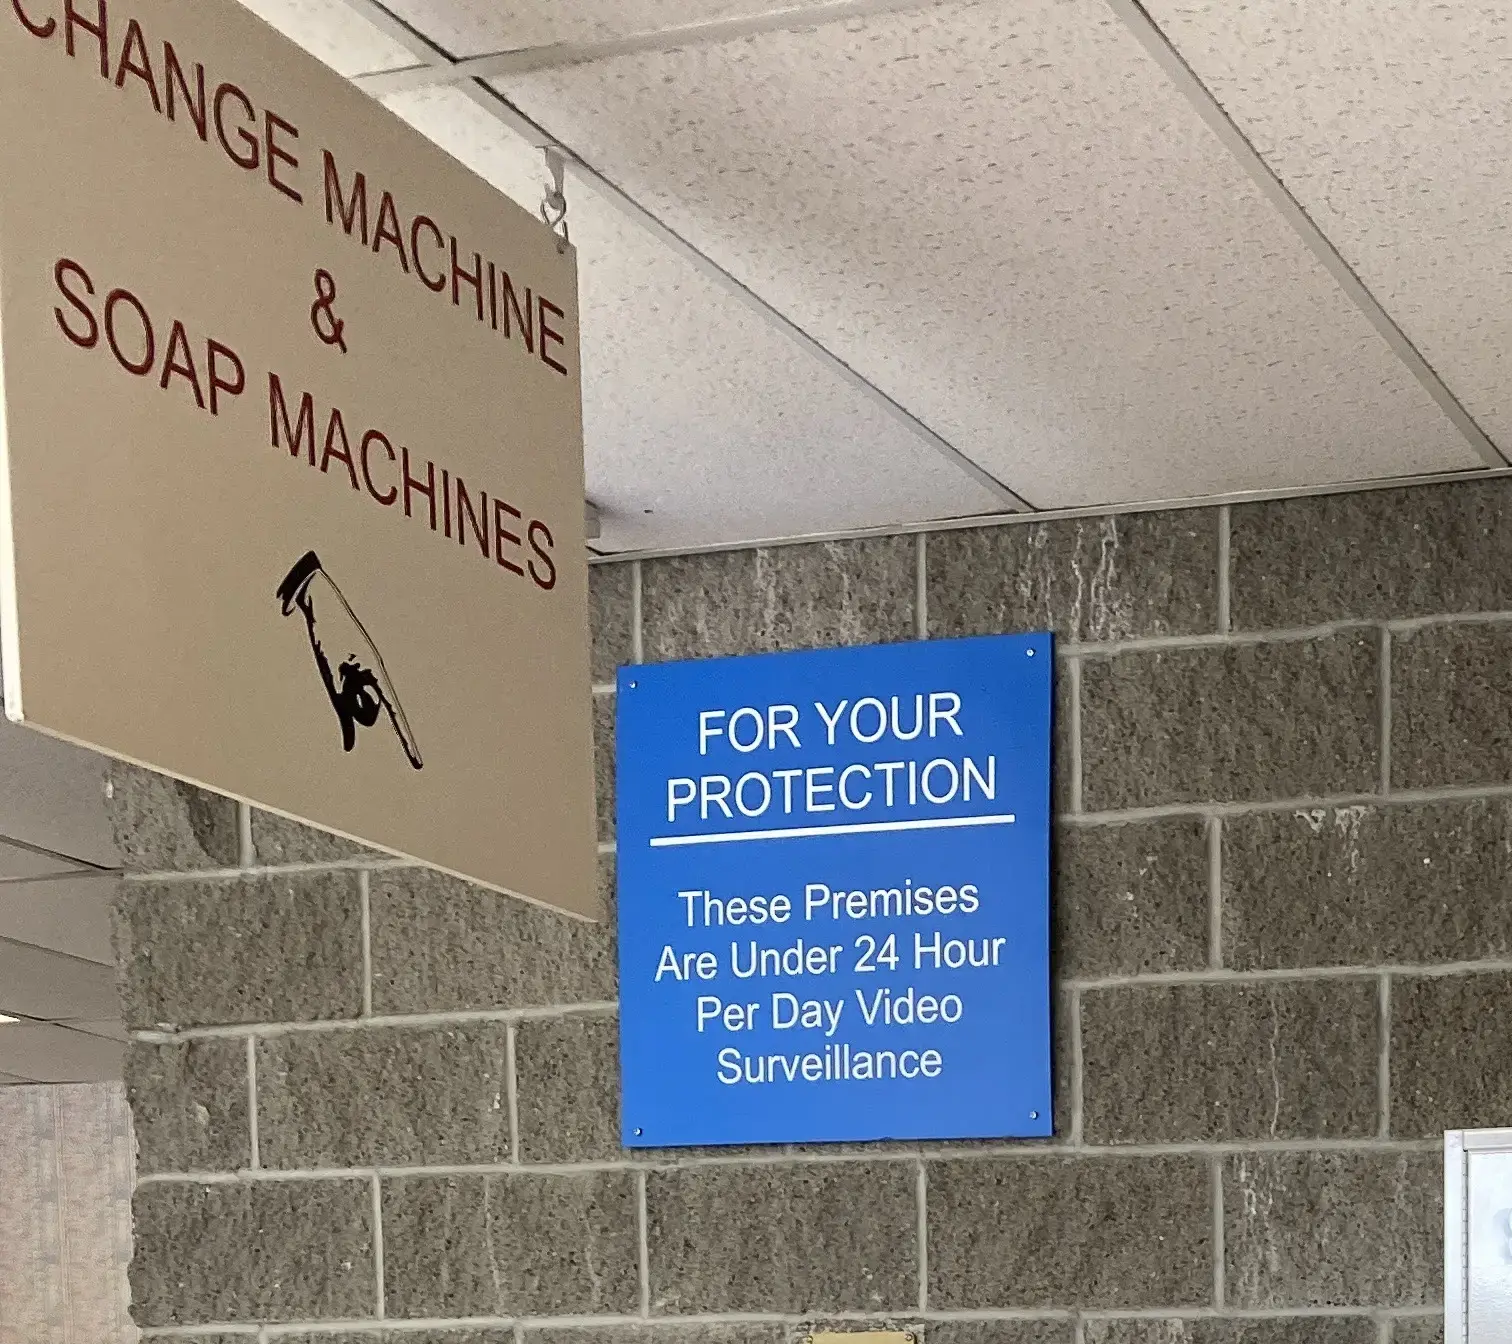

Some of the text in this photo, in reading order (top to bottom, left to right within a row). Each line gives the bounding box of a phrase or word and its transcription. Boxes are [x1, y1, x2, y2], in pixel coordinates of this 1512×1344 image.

[322, 149, 568, 376] MACHINE
[310, 268, 348, 354] &
[54, 257, 558, 591] SOAP MACHINES
[698, 691, 963, 755] FOR YOUR
[667, 755, 996, 822] PROTECTION
[678, 878, 979, 927] These Premises
[655, 931, 1006, 983] Are Under 24 Hour
[697, 986, 963, 1037] Per Day Video
[717, 1043, 943, 1085] Surveillance
